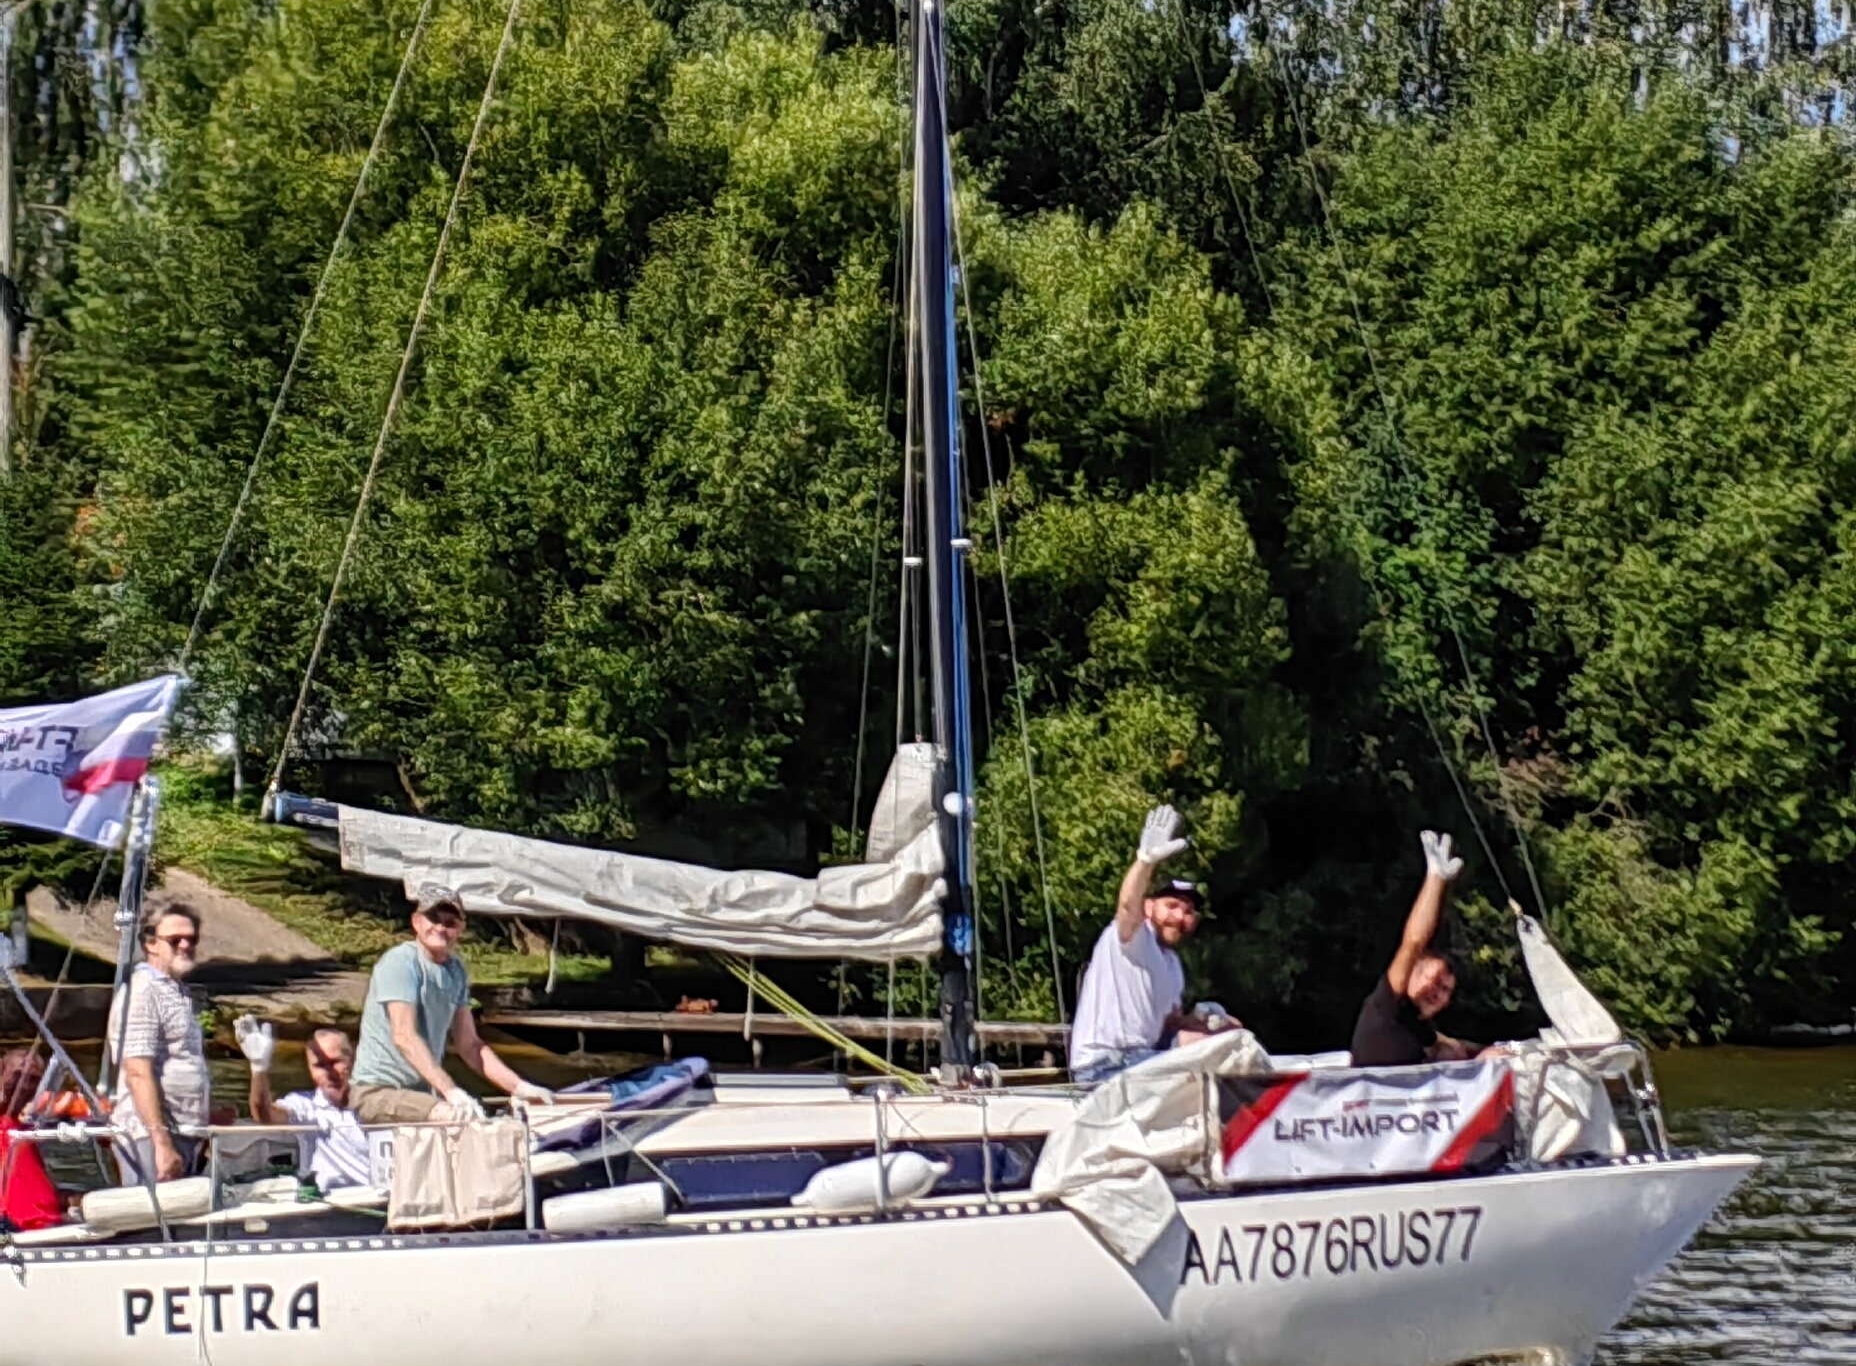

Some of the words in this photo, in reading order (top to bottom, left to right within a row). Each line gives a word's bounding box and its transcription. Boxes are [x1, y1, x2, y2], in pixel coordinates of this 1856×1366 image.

[1275, 1109, 1459, 1142] LIFT-IMPORT
[1180, 1206, 1482, 1285] AA7876RUS77
[123, 1281, 320, 1335] PETRA
